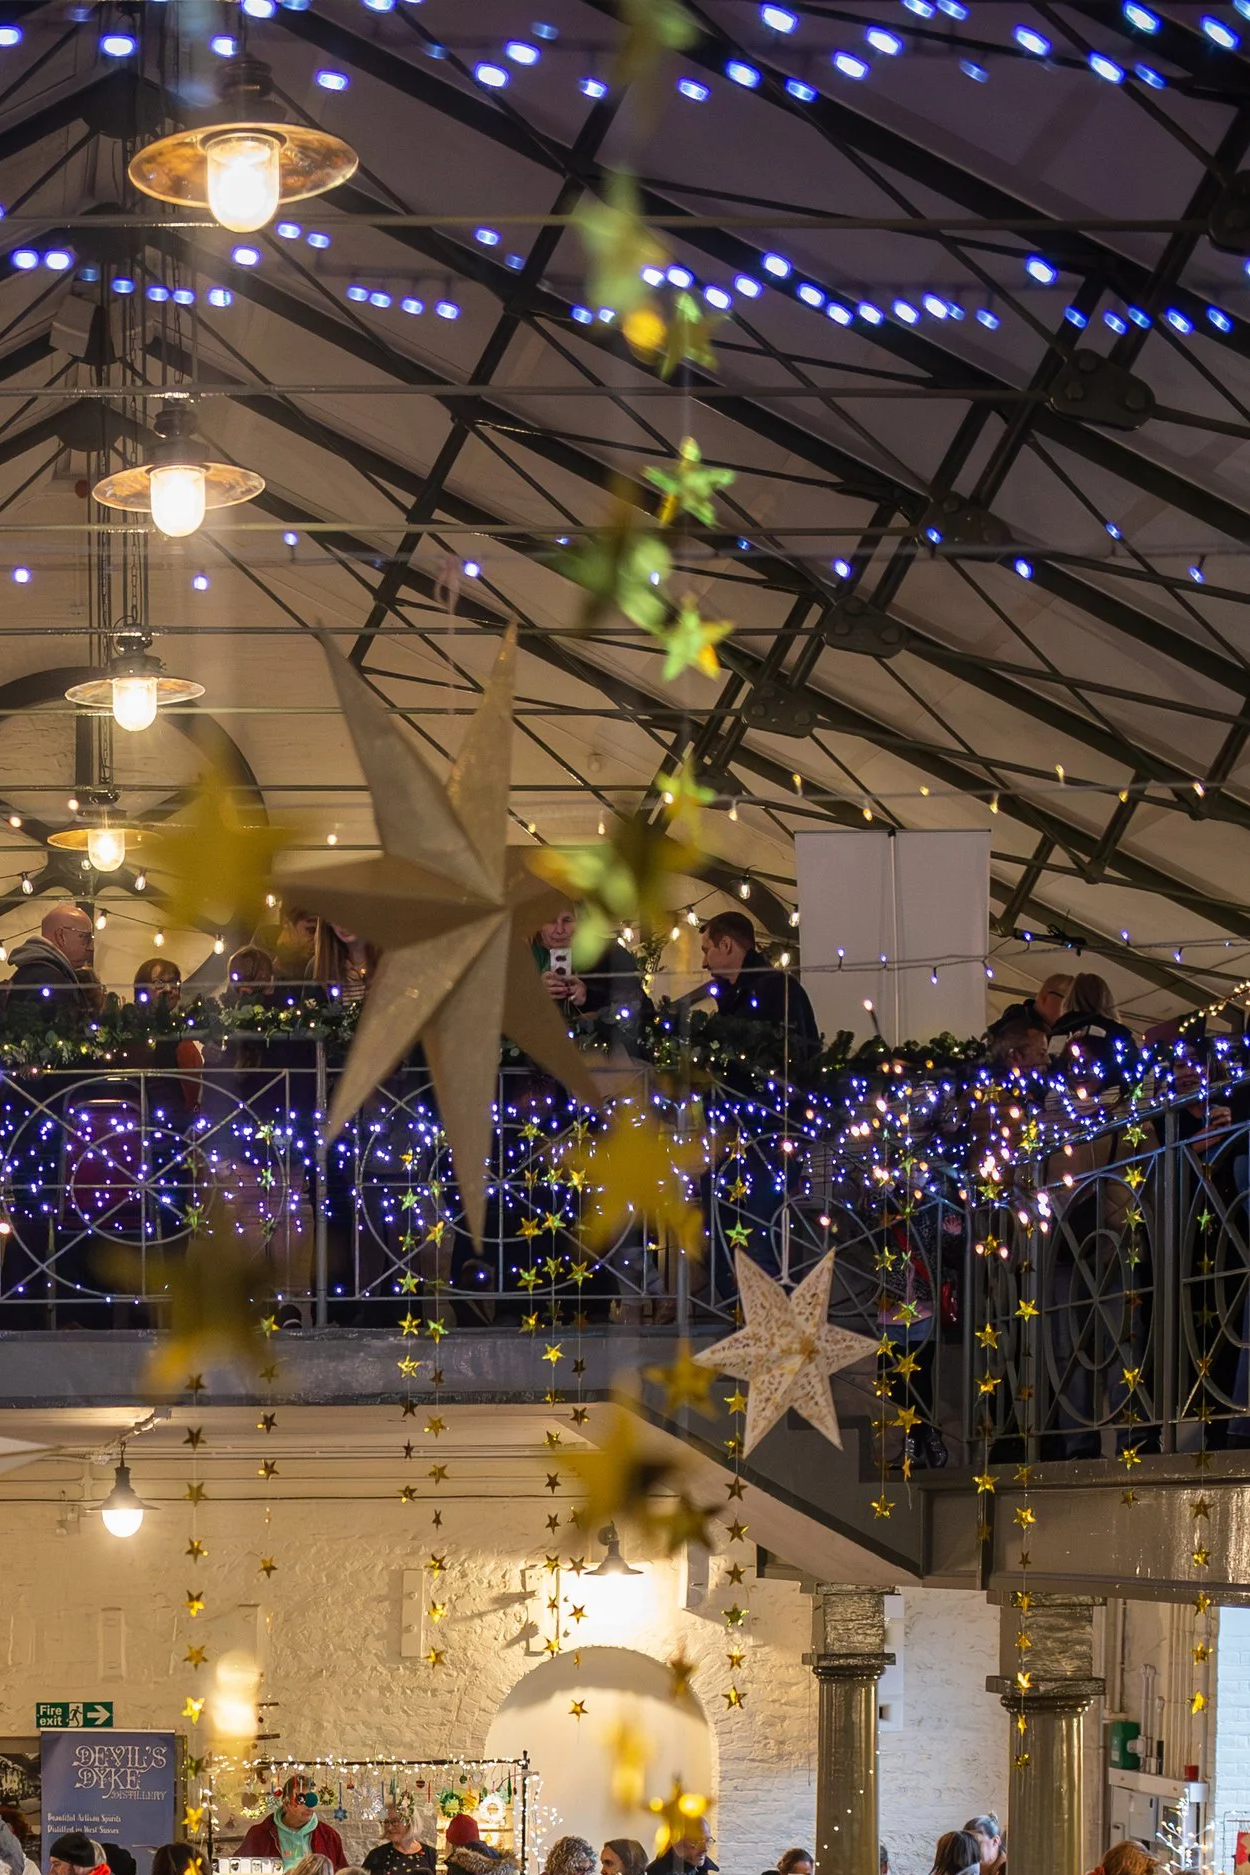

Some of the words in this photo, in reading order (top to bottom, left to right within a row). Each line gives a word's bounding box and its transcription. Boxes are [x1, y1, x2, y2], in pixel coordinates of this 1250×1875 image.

[40, 1705, 62, 1715] Fire
[40, 1716, 62, 1725] exit
[72, 1745, 166, 1770] DEVIL'S
[74, 1767, 140, 1798] DYKE
[111, 1790, 166, 1800] DISTILLERY
